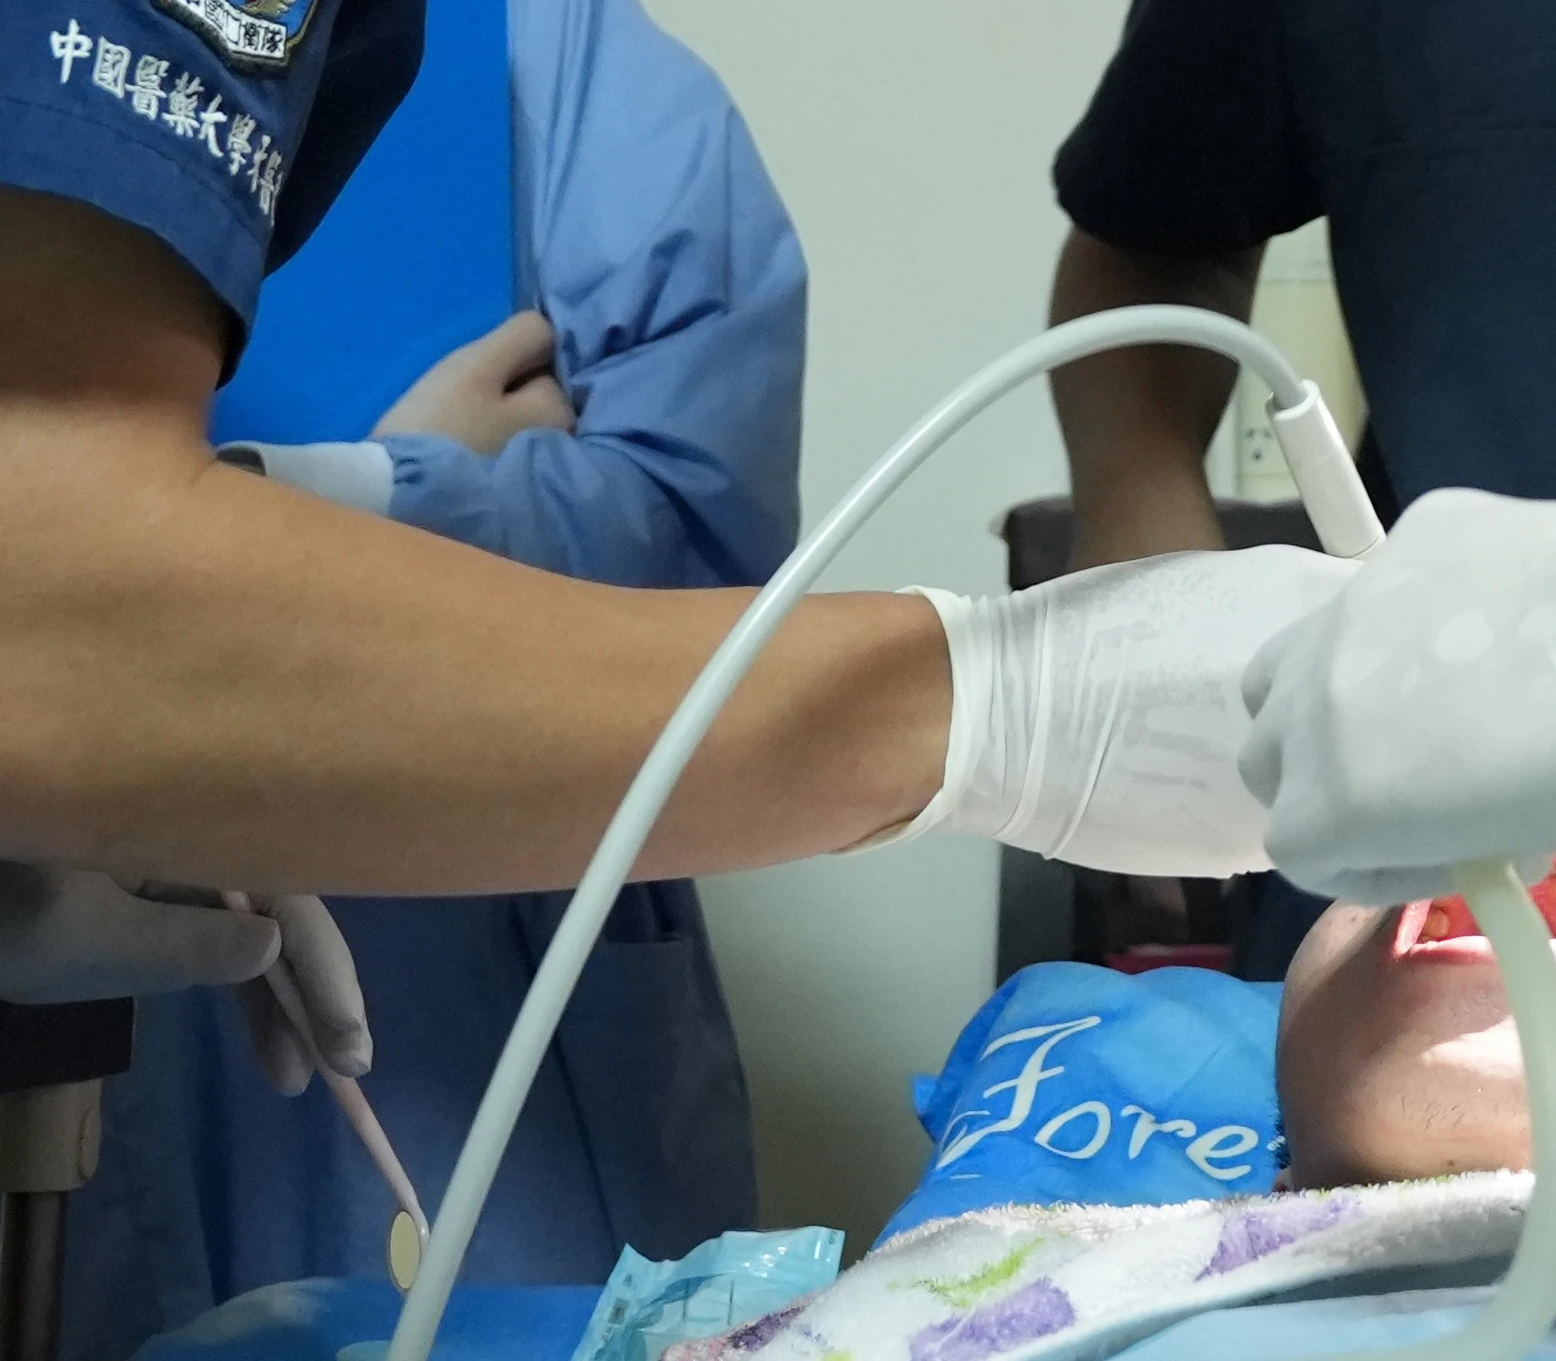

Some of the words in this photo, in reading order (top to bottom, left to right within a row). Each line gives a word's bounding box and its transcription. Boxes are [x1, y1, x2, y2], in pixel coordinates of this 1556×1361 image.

[50, 18, 284, 226] 中國醫藥大學牙醫
[936, 1015, 1286, 1181] Fore
